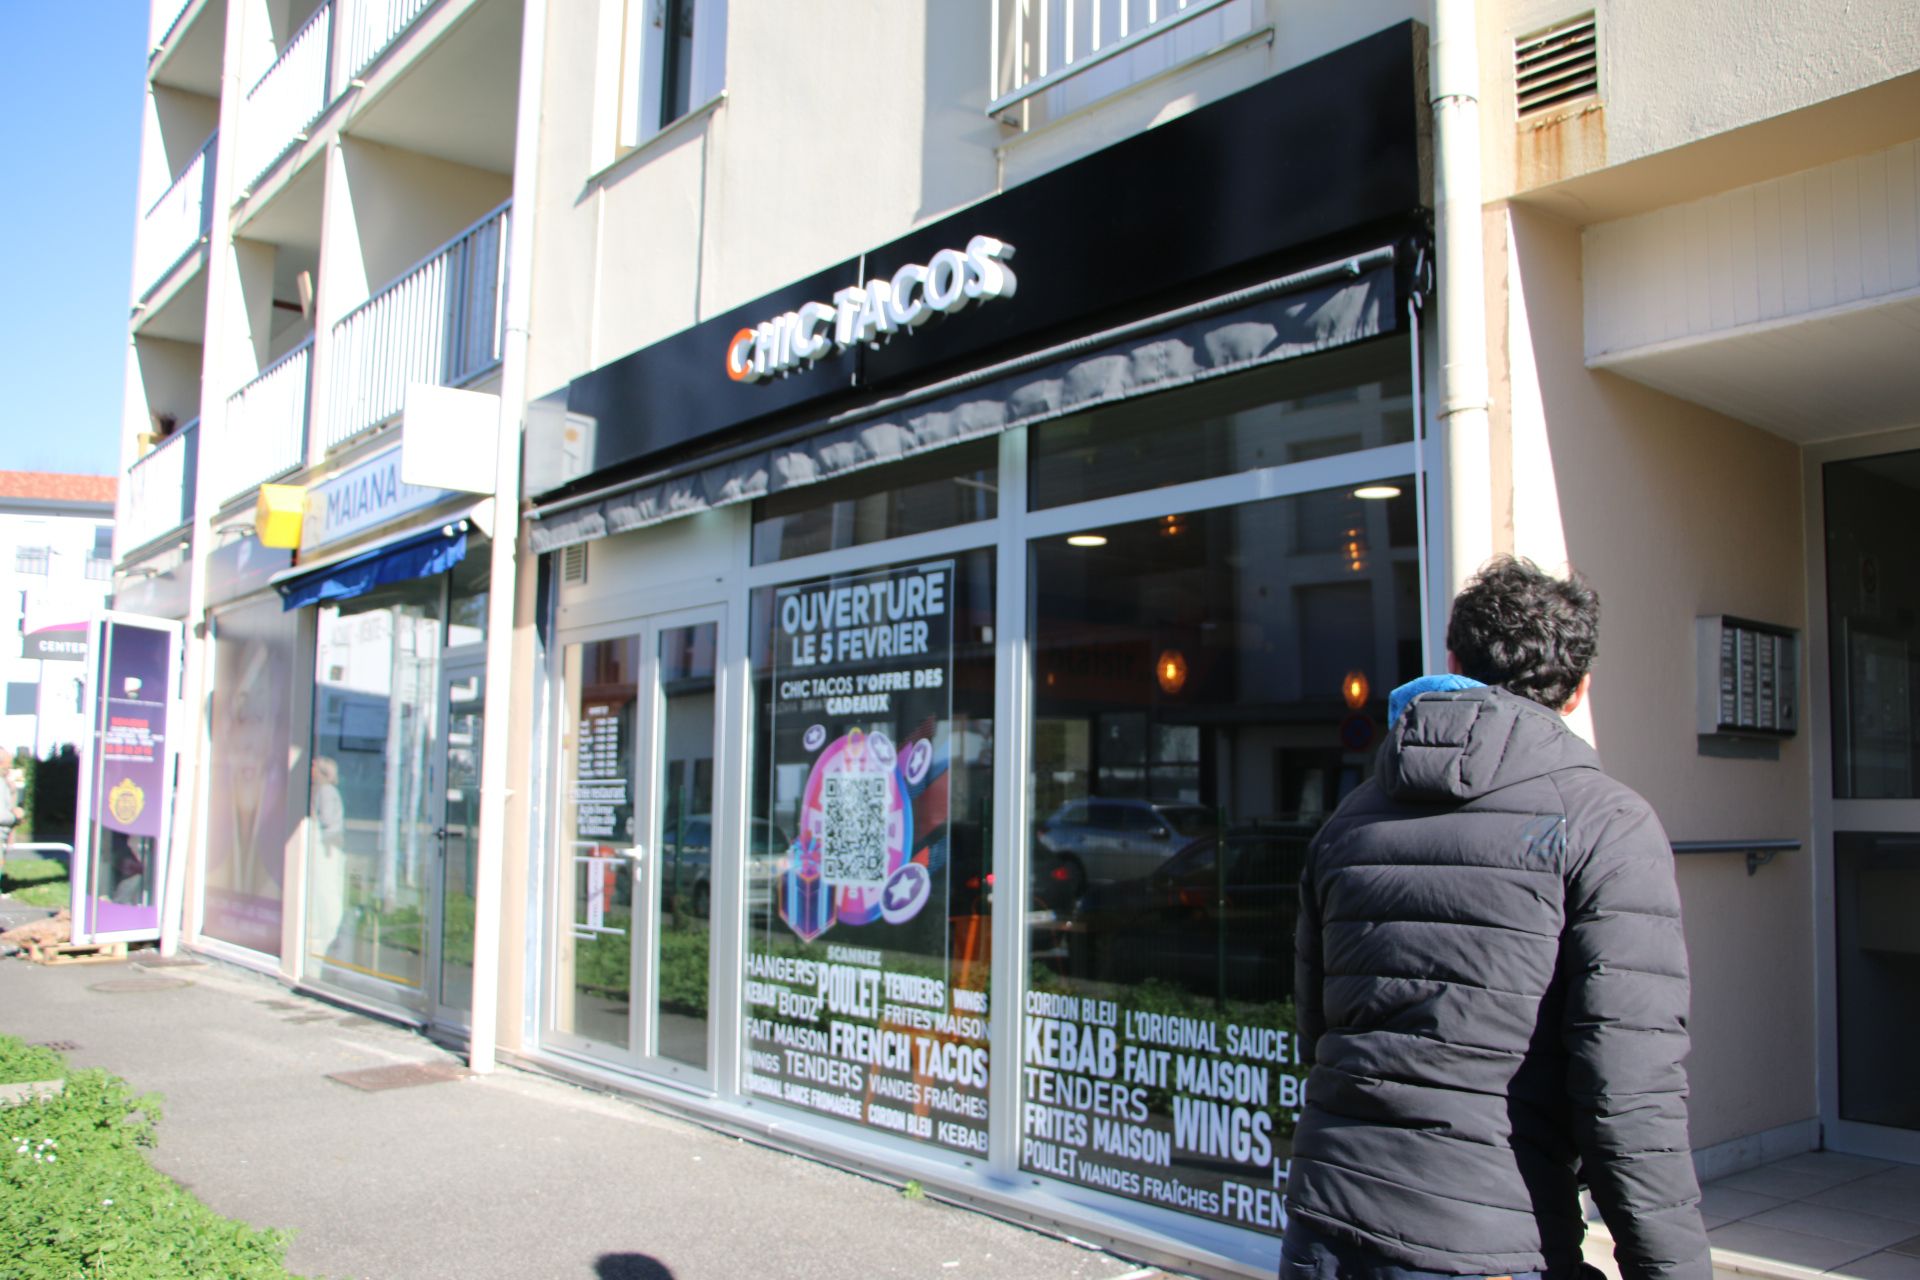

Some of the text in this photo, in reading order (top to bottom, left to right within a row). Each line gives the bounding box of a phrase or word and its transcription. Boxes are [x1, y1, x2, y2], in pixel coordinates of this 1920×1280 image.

[726, 235, 1017, 384] CHIC TACOS
[326, 462, 398, 531] MAIANA
[781, 572, 945, 635] OUVERTURE
[792, 620, 929, 667] LE 5 FEVRIER
[780, 667, 943, 700] CHIC TACOS T'OFFRE DES
[825, 693, 890, 716] CADEAUX
[827, 945, 882, 967] SCANNEZ
[778, 991, 820, 1022] BODZ
[817, 962, 881, 1019] POULET
[883, 971, 944, 1008] TENDERS
[953, 987, 987, 1013] WINGS
[1026, 990, 1118, 1028] CORDON BLEU
[744, 1017, 828, 1055] FAIT MAISON
[884, 1004, 992, 1041] FRITES MAISON
[1125, 1009, 1221, 1054] L'ORIGINAL
[1225, 1024, 1289, 1063] SAUCE
[745, 1049, 780, 1074] WINGS
[830, 1020, 989, 1090] FRENCH TACOS
[1024, 1015, 1118, 1078] KEBAB
[784, 1050, 864, 1092] TENDERS
[784, 1081, 810, 1105] SAUCE
[1124, 1045, 1269, 1106] FAIT MAISON
[869, 1073, 988, 1120] VIANDES FRAÎCHES
[1024, 1065, 1149, 1122] TENDERS
[868, 1103, 932, 1138] CORDON BLEU
[938, 1121, 989, 1152] KEBAB
[1024, 1101, 1171, 1168] FRITES MAISON
[1172, 1096, 1273, 1167] WINGS
[1024, 1137, 1219, 1215] POULET VIANDES FRAÎCHES
